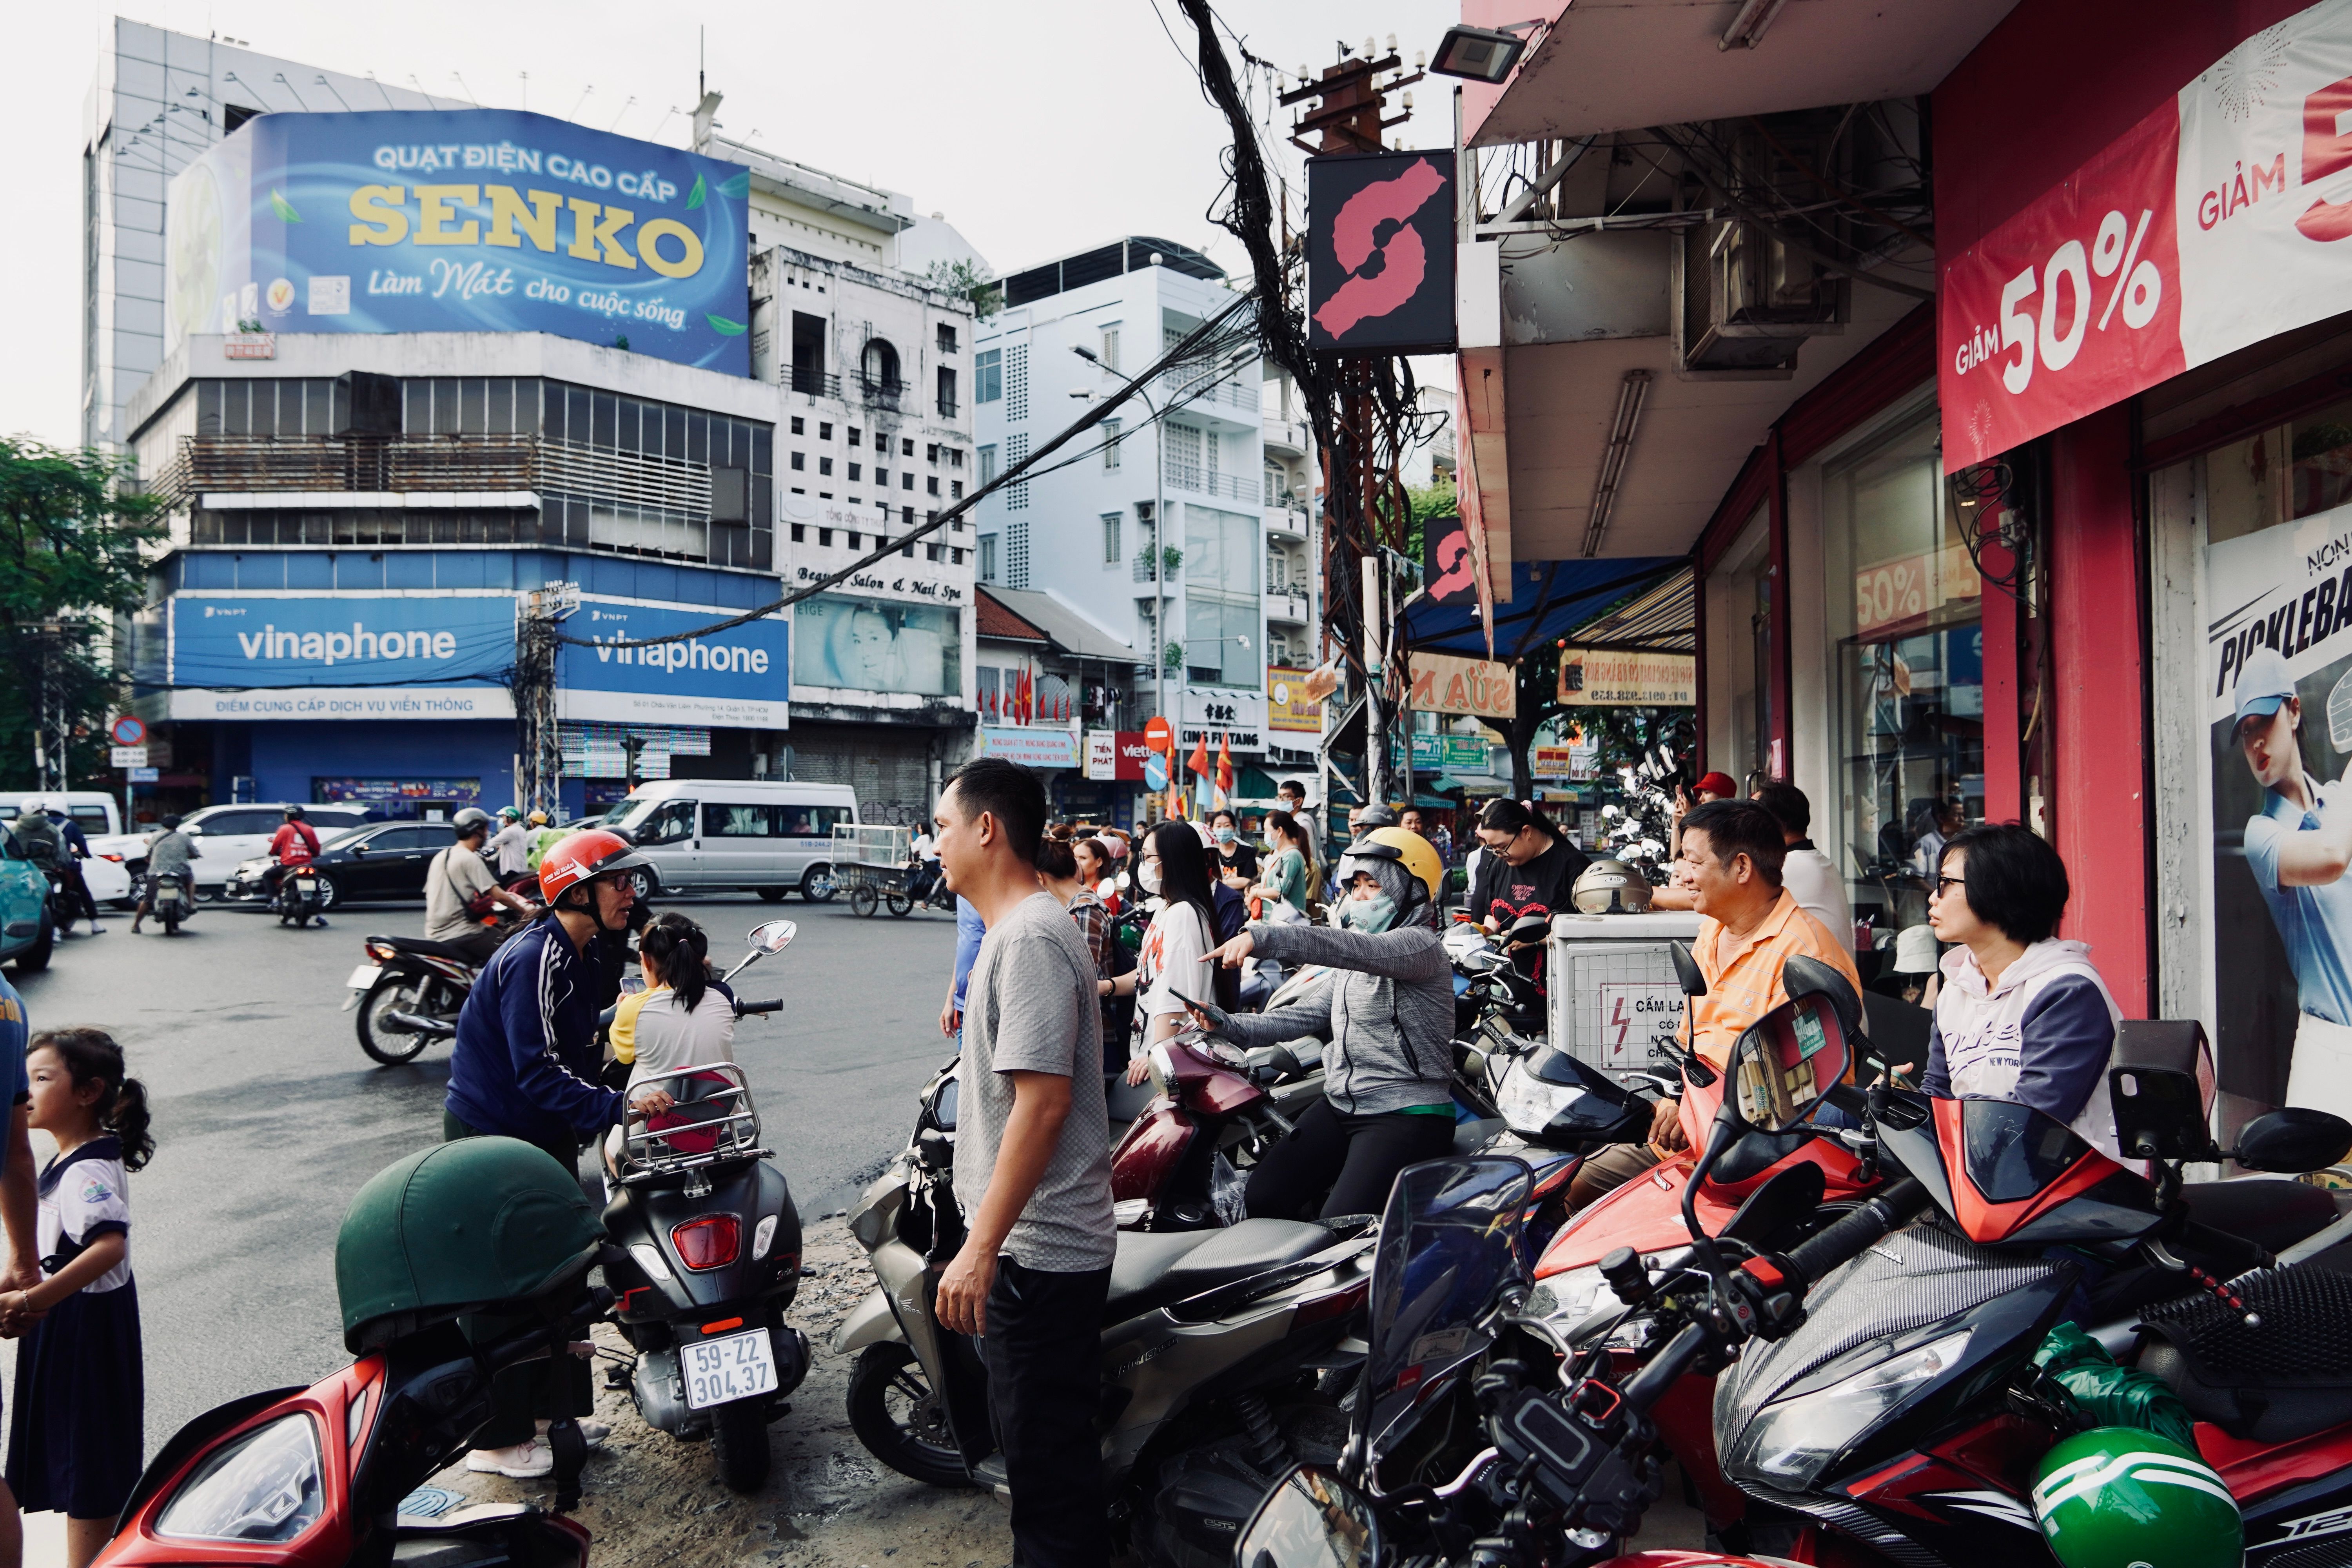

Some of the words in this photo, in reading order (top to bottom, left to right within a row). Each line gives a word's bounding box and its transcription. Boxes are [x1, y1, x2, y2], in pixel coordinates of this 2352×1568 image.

[375, 147, 459, 173] QUẠT
[465, 143, 541, 174] ĐIỆN
[547, 155, 612, 188] CAO
[617, 172, 677, 202] CẤP
[2198, 152, 2285, 231] GIẢM
[349, 185, 704, 279] SENKO
[368, 270, 421, 294] Làm
[430, 258, 513, 299] Mát
[525, 278, 569, 302] cho
[578, 290, 629, 316] cuộc
[634, 299, 684, 328] sống
[1955, 323, 1999, 375] GIẢM
[2000, 209, 2161, 394] 50%
[2308, 534, 2349, 577] NON
[851, 574, 884, 589] Salon
[893, 578, 904, 592] &
[911, 581, 938, 595] Nail
[942, 585, 961, 601] Spa
[602, 613, 628, 622] VNPT
[794, 602, 824, 617] EIGE
[238, 622, 456, 665] vinaphone
[593, 629, 769, 674] vinaphone
[216, 697, 249, 712] ĐIỂM
[254, 701, 293, 712] CUNG
[298, 696, 325, 712] CẤP
[330, 701, 362, 714] DỊCH
[367, 701, 385, 715] VỤ
[390, 695, 420, 711] VIỄN
[426, 697, 473, 711] THÔNG
[1094, 741, 1112, 753] TIẾN
[1122, 744, 1156, 758] viett
[1229, 733, 1258, 746] TANG
[1093, 755, 1113, 765] PHÁT
[1636, 996, 1664, 1013] CẤM
[1669, 1000, 1684, 1015] LẠ
[1659, 1019, 1674, 1029] CÓ
[1989, 1057, 2002, 1066] NEW
[1868, 1205, 1886, 1223] YONEX
[696, 1336, 760, 1372] 59-Z2
[695, 1362, 767, 1403] 304.37
[2290, 1511, 2352, 1535] 12
